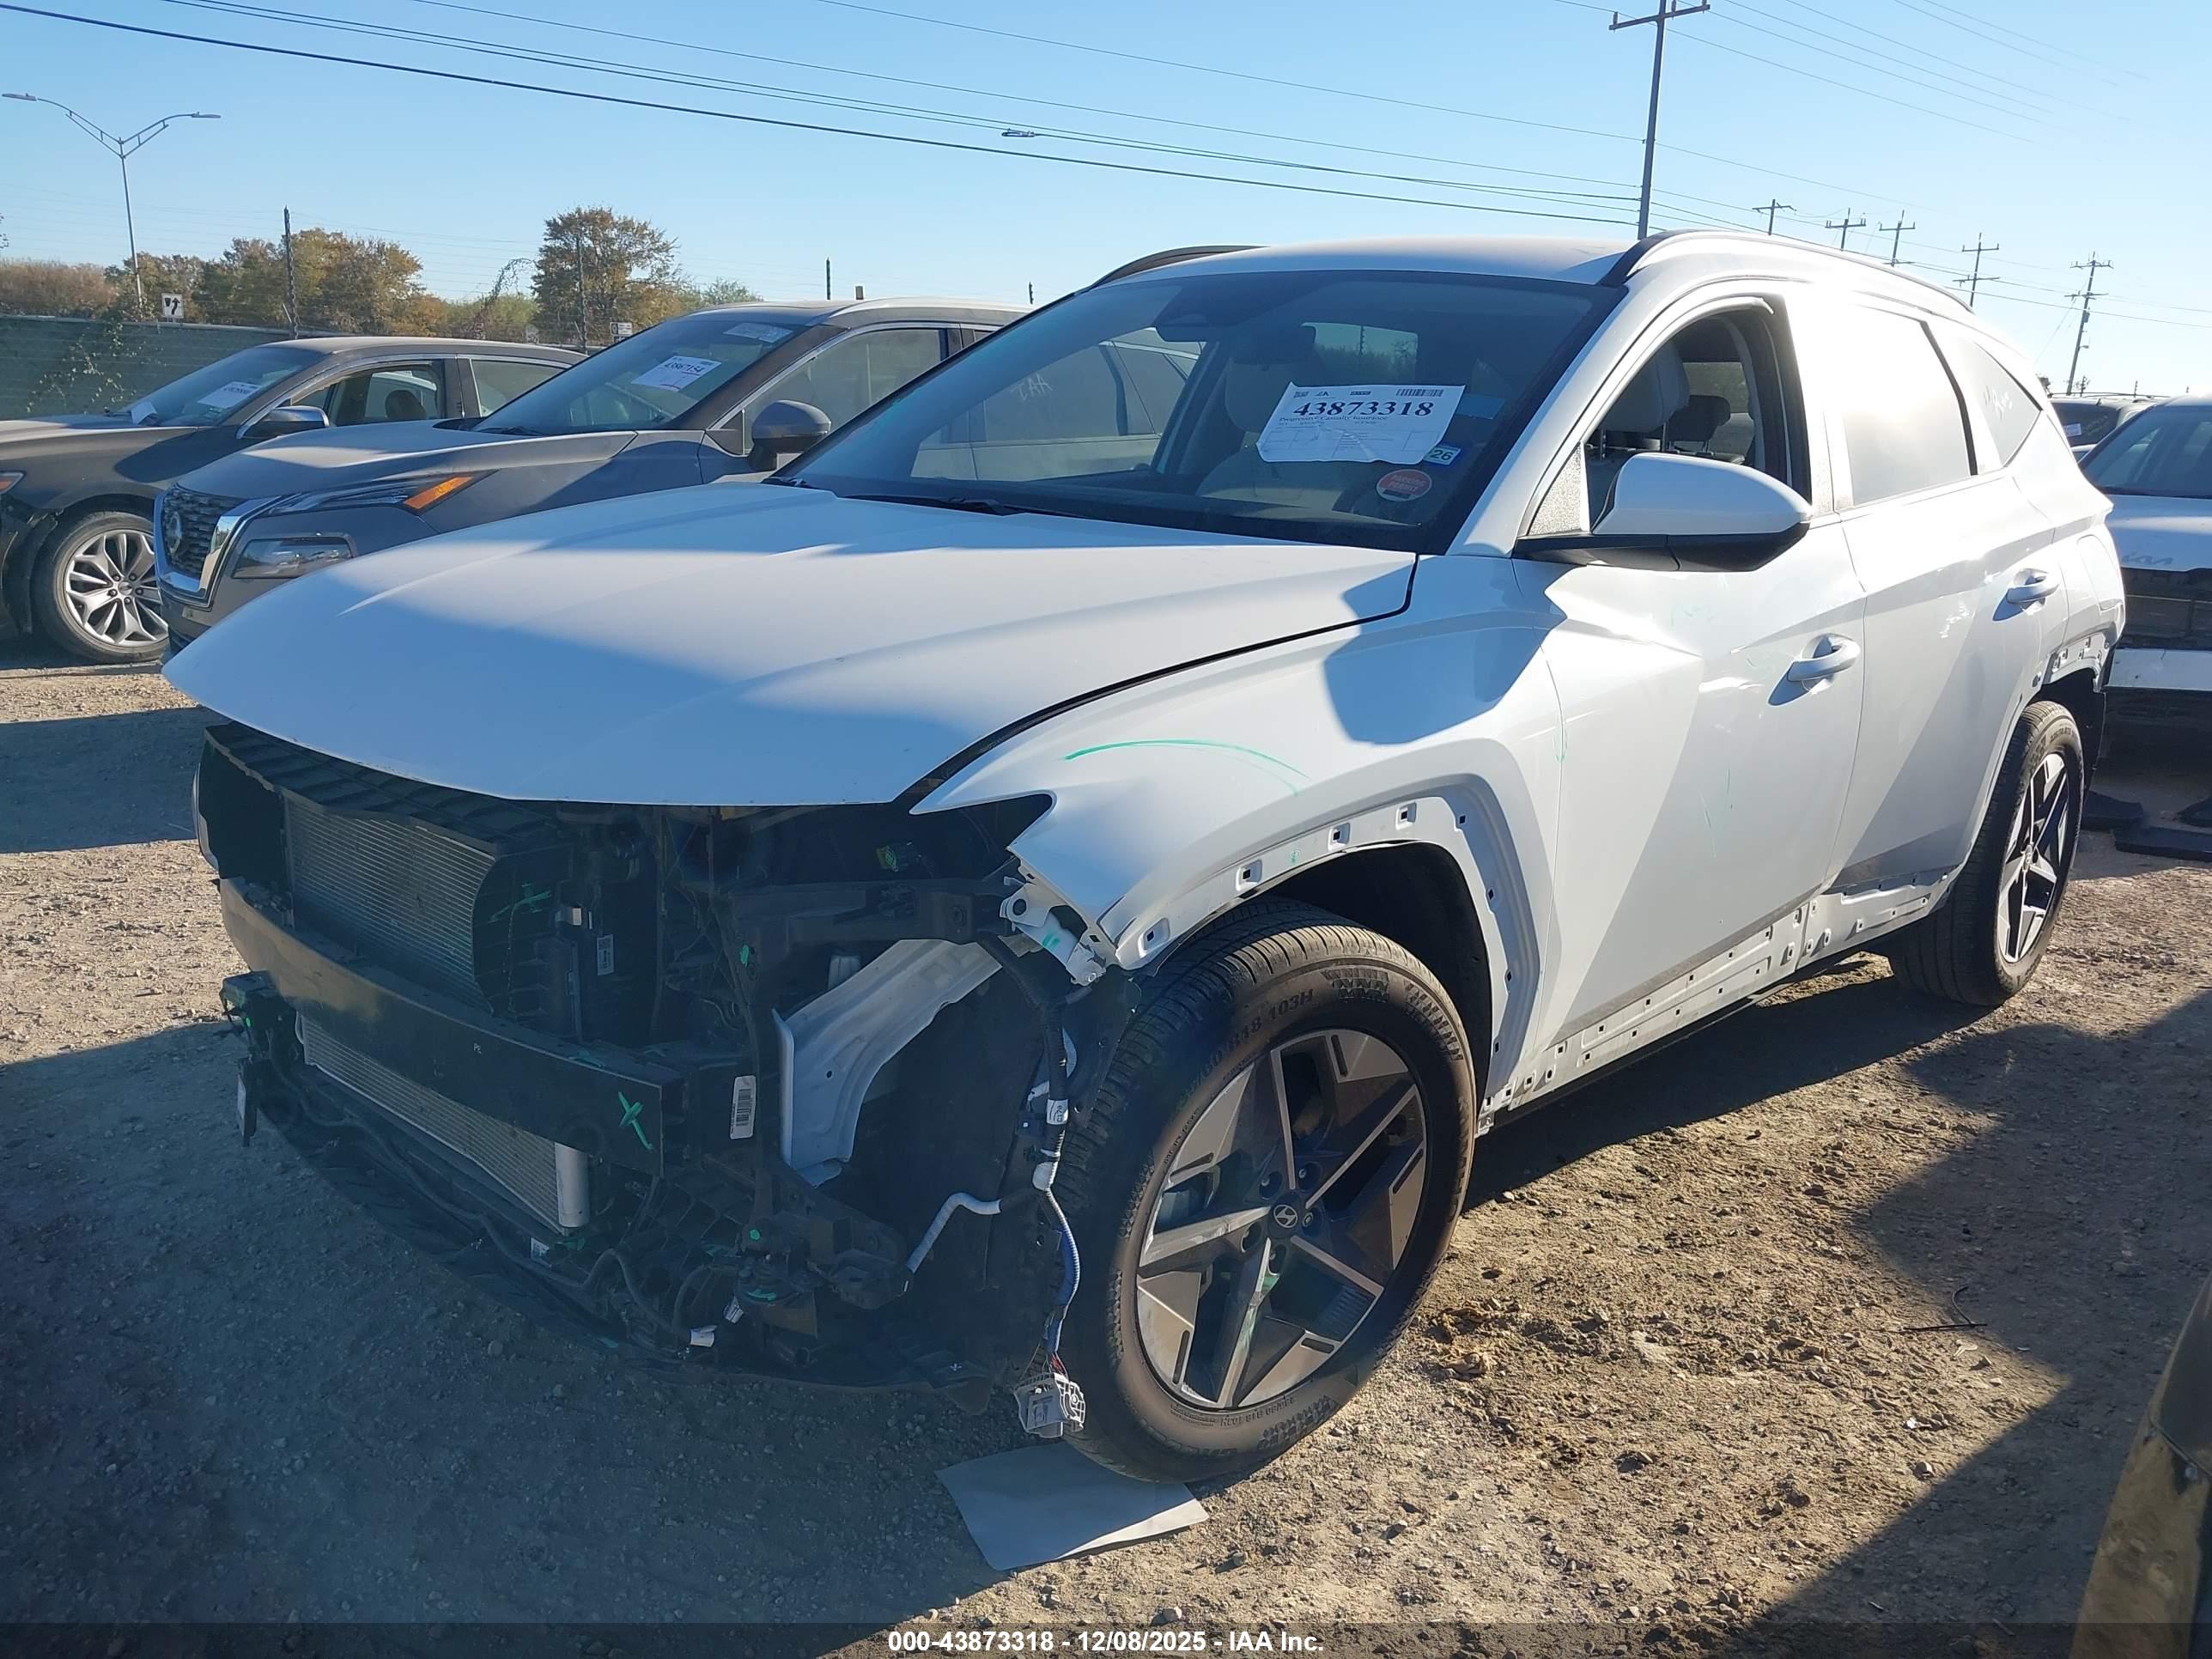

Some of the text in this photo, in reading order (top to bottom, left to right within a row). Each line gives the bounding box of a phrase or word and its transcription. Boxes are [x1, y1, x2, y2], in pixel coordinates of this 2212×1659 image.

[1293, 401, 1435, 416] 43873318
[1431, 449, 1453, 460] 26
[1268, 988, 1314, 1021] 103H
